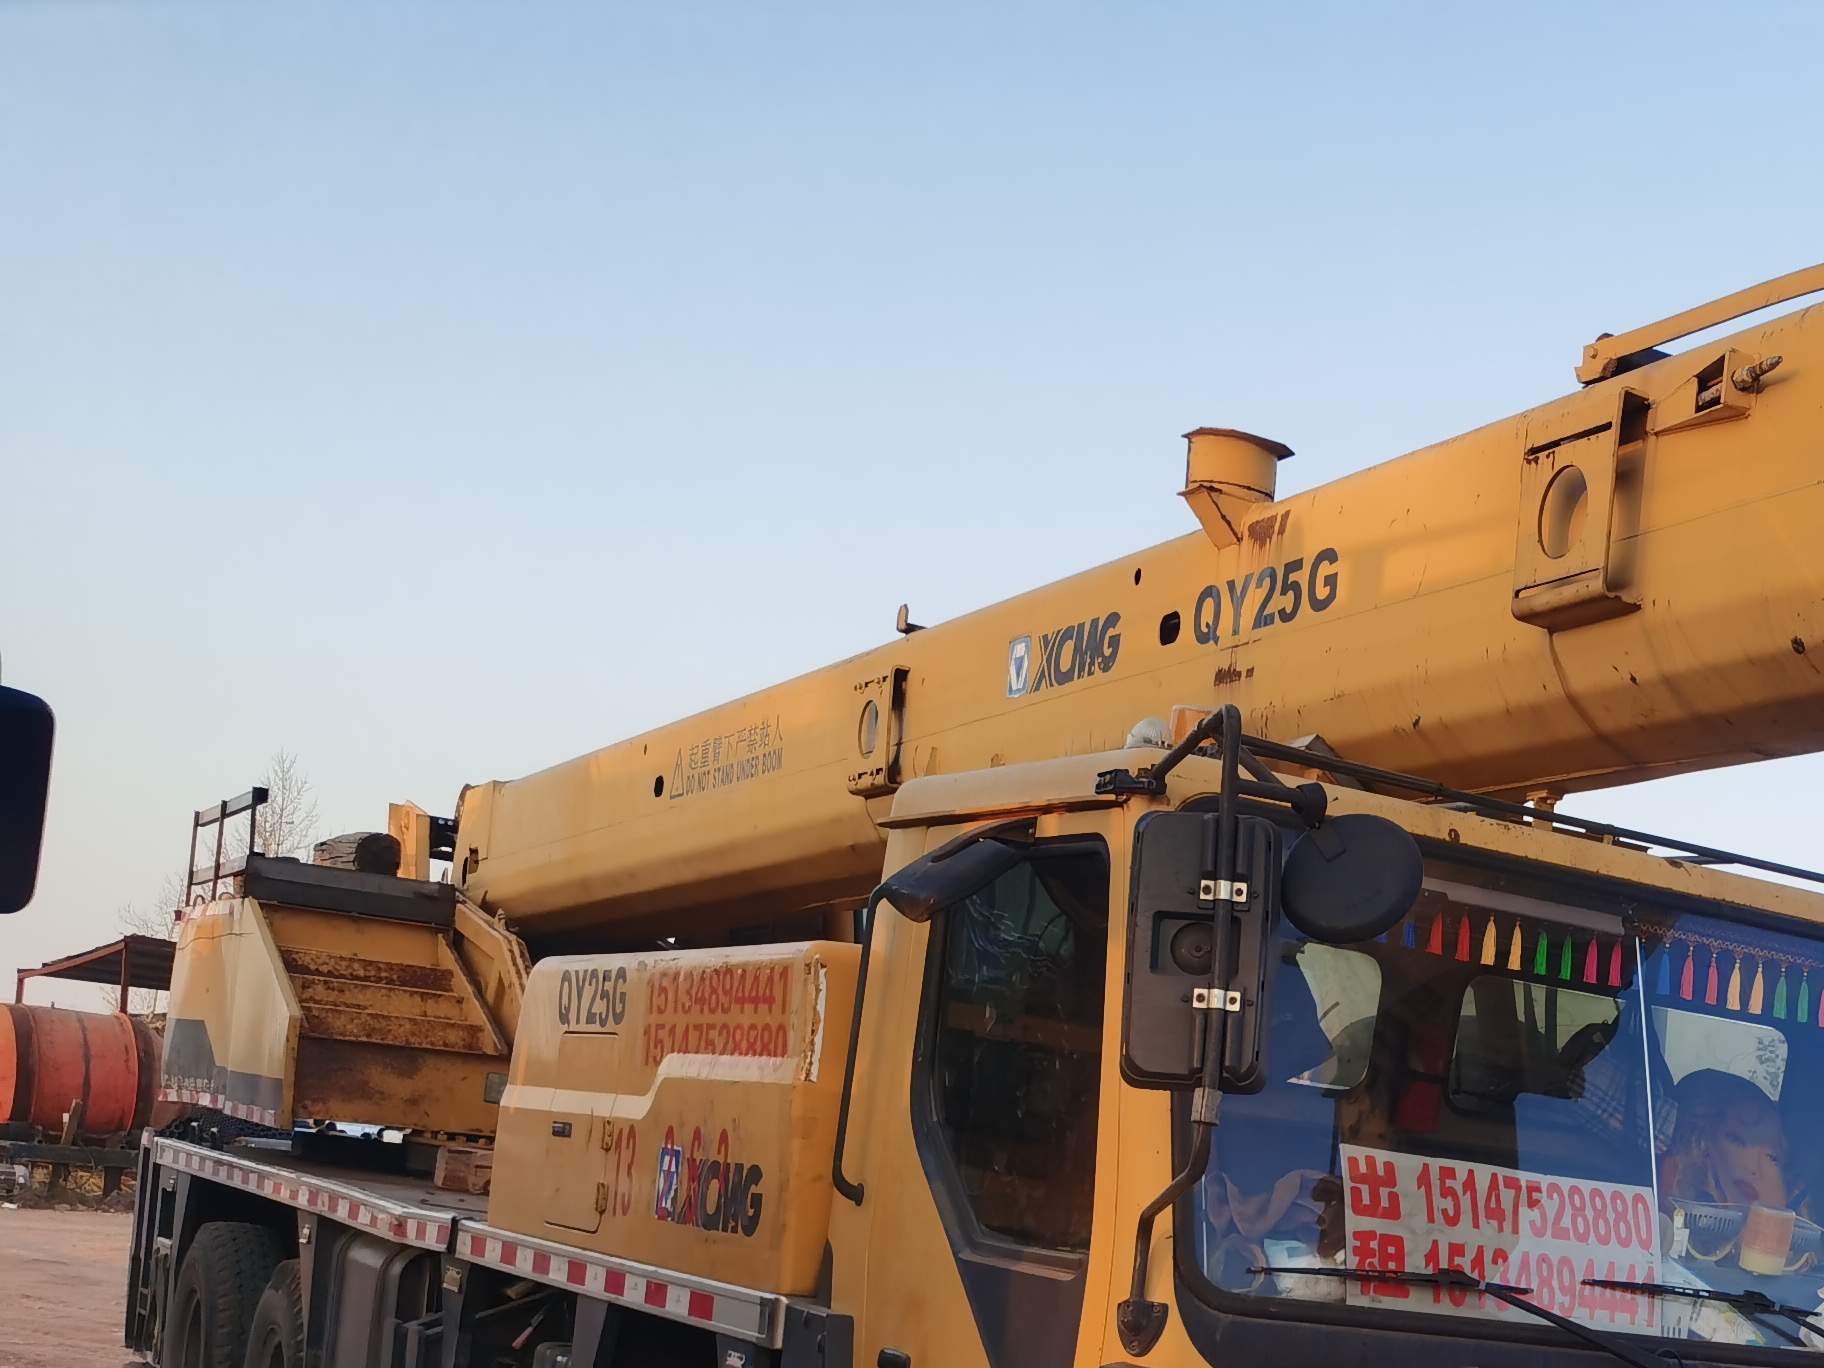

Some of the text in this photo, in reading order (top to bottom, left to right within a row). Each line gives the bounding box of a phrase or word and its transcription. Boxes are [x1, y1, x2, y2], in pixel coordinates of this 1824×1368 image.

[1194, 548, 1339, 645] QY25G
[1028, 612, 1122, 694] XCMG
[686, 747, 783, 795] DO NOT STAND UNDER BOOM
[558, 967, 627, 1027] QY25G
[647, 965, 789, 1014] 15134894441
[676, 1158, 763, 1237] XCMG
[1417, 1162, 1654, 1251] 15147528880
[1424, 1239, 1657, 1329] 15134894441
